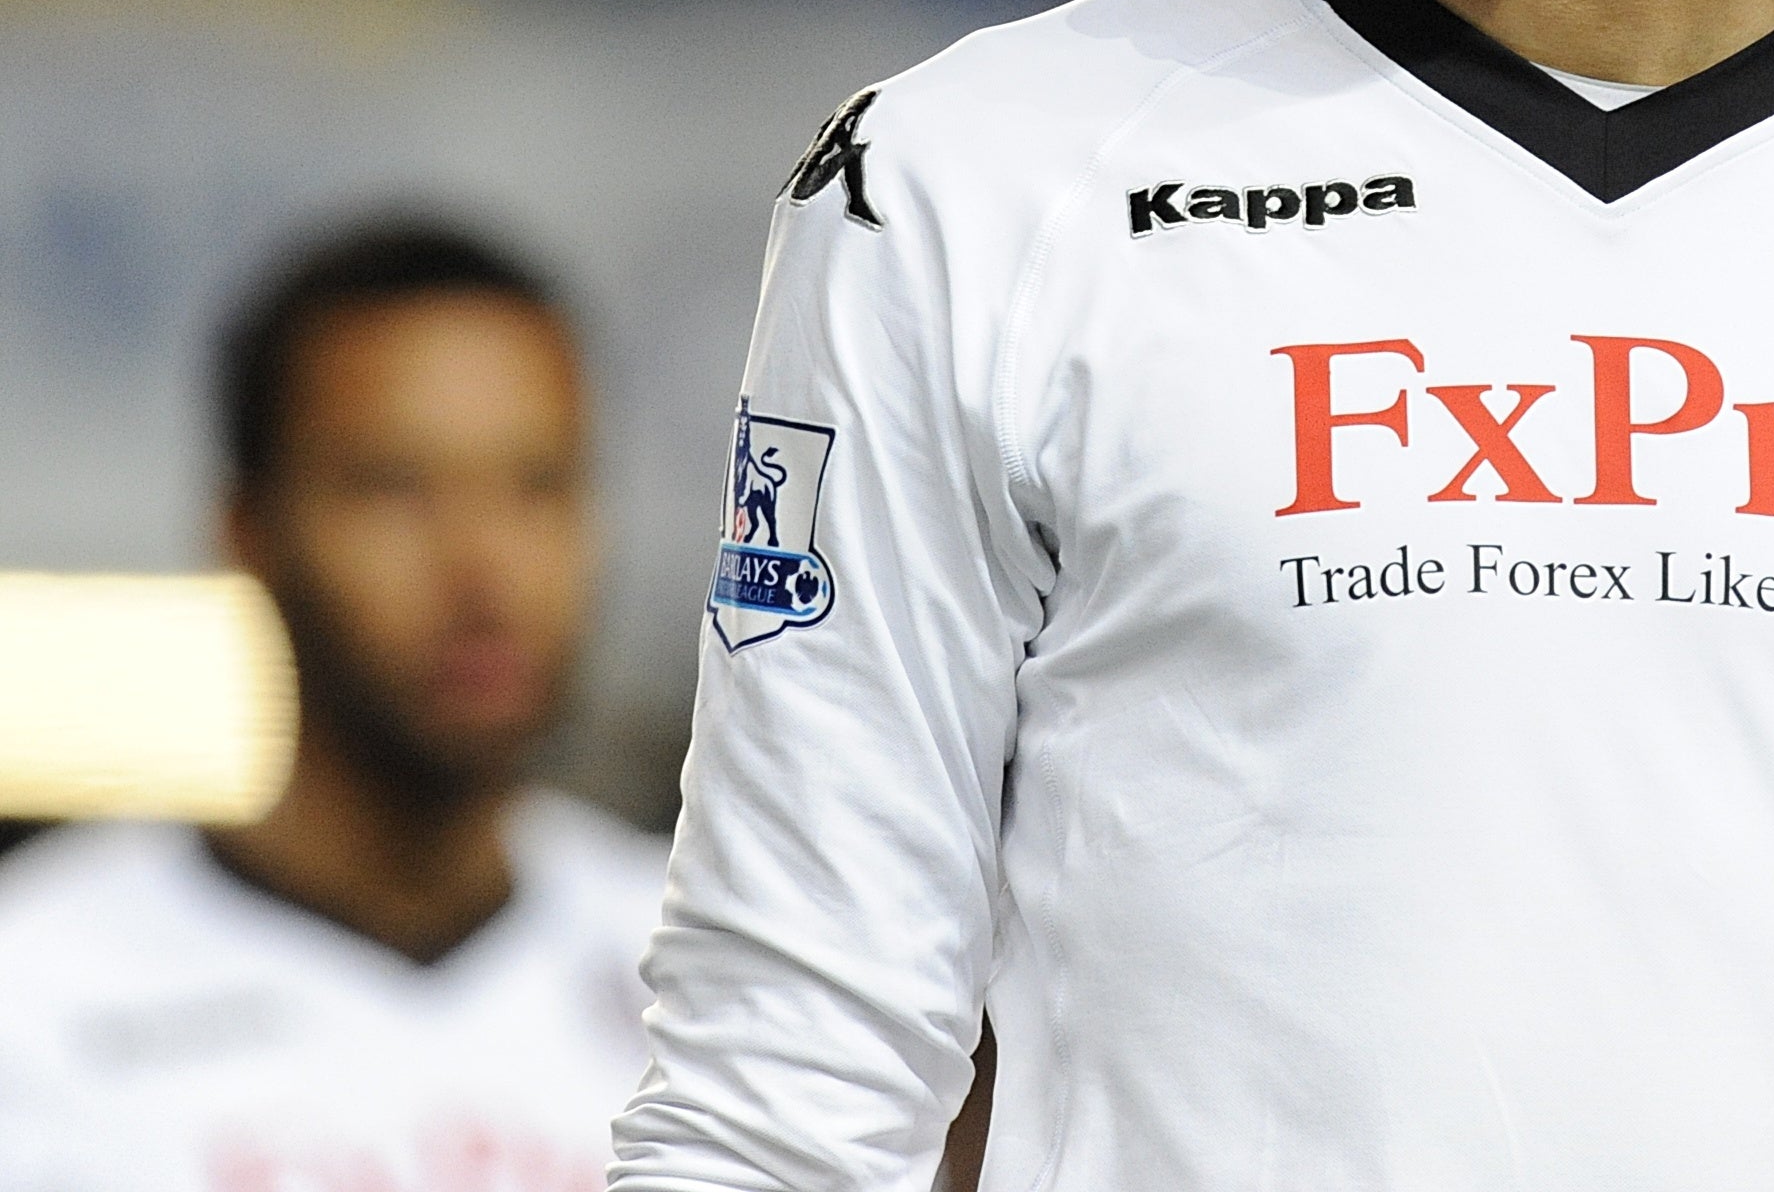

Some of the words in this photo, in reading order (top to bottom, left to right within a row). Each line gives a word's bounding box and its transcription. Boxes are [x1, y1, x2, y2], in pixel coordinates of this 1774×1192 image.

[1129, 174, 1416, 235] Kappa
[1279, 545, 1445, 608] Trade
[1467, 544, 1633, 601] Forex
